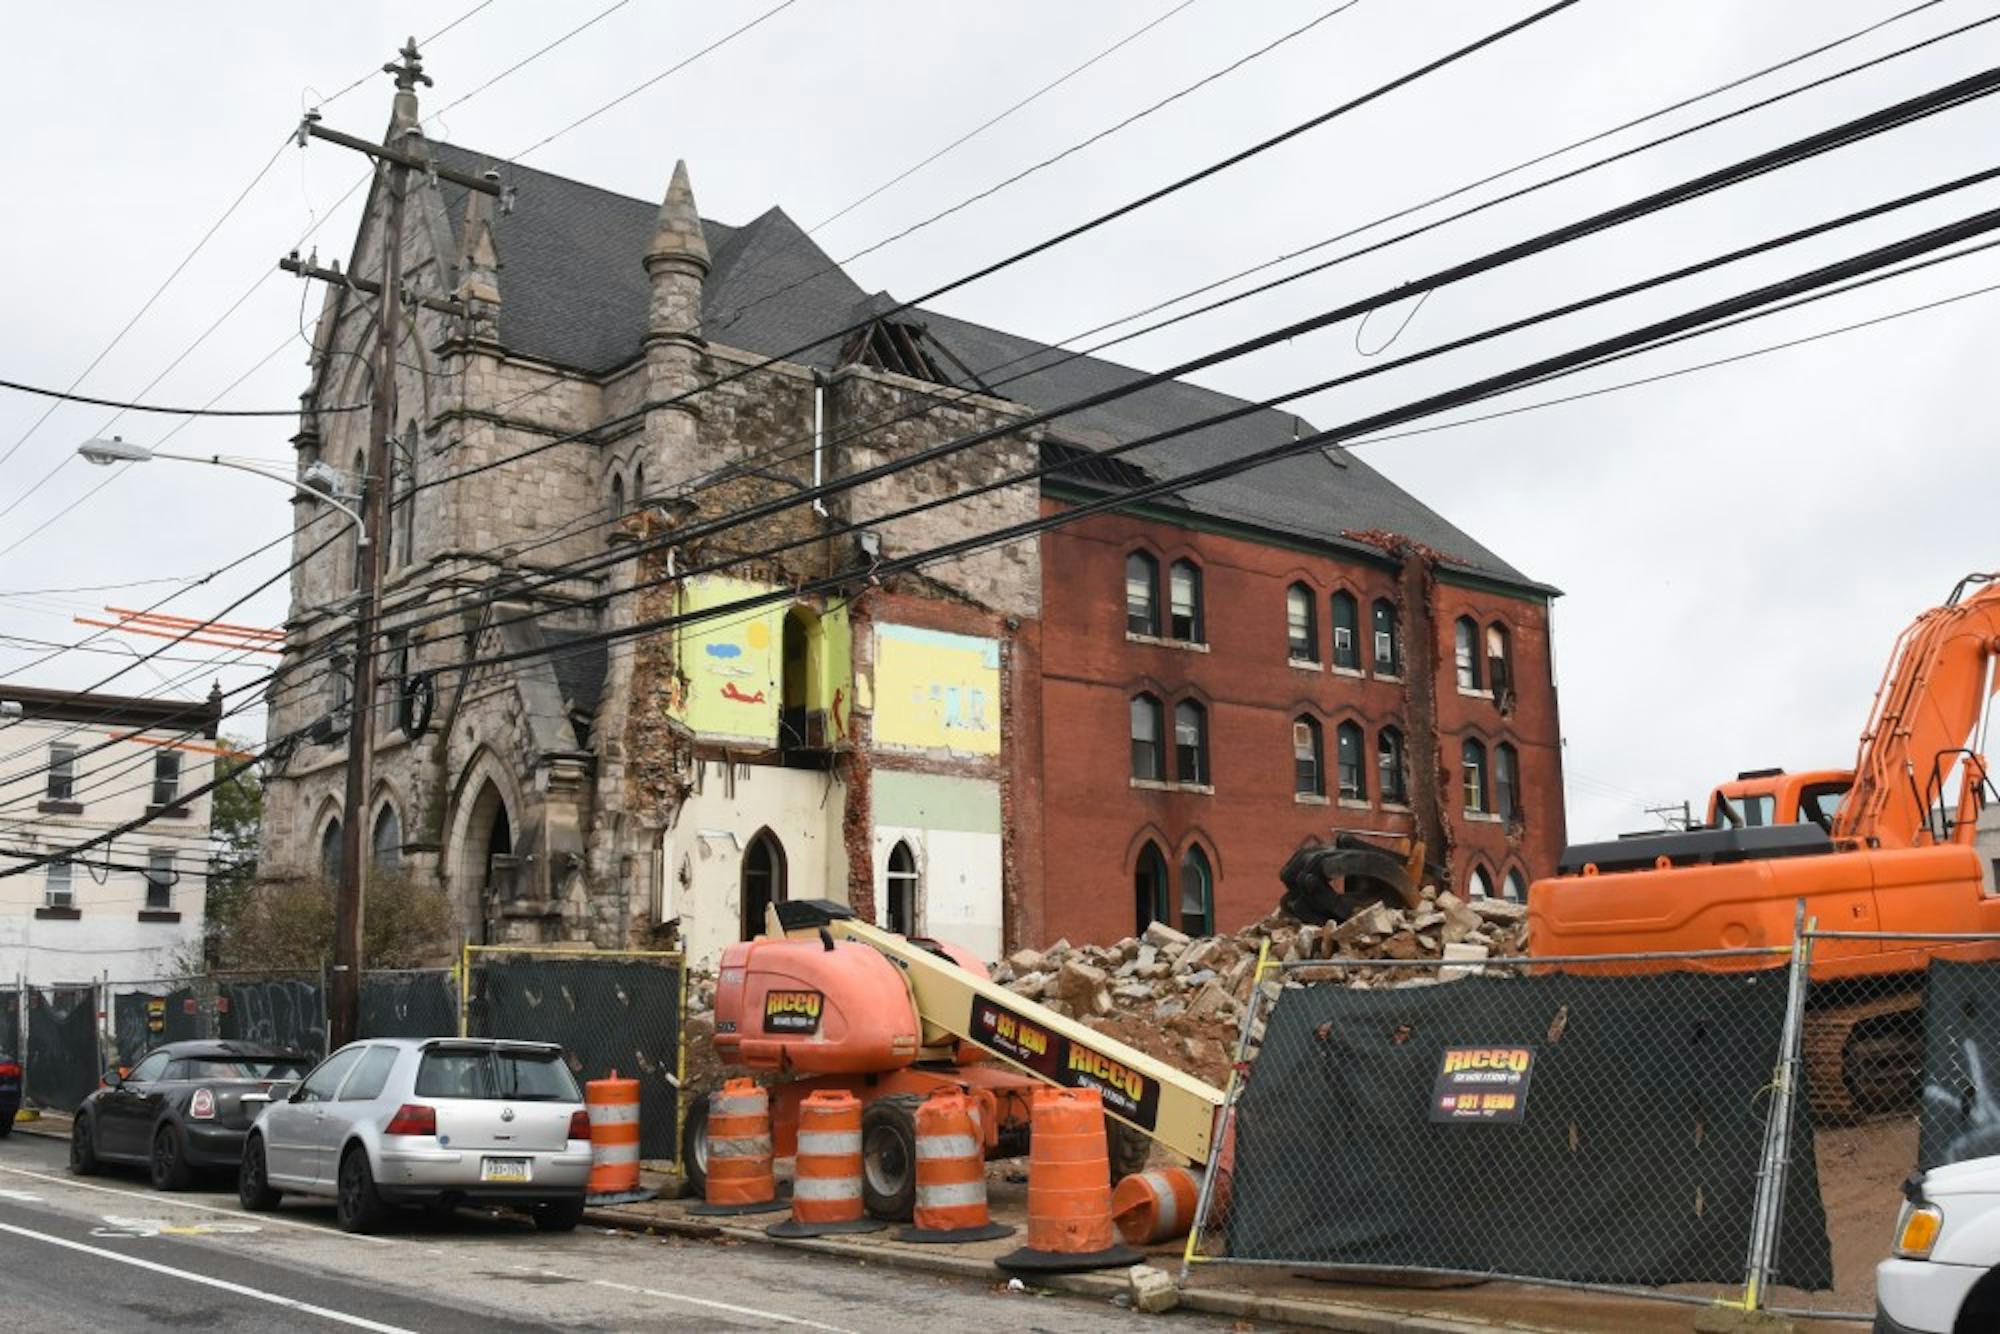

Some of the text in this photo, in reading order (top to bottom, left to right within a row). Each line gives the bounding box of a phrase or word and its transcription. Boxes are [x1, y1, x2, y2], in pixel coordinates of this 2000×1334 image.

[767, 992, 820, 1017] RICCO
[1068, 1040, 1143, 1102] RICCO
[1443, 1048, 1529, 1074] RICCO
